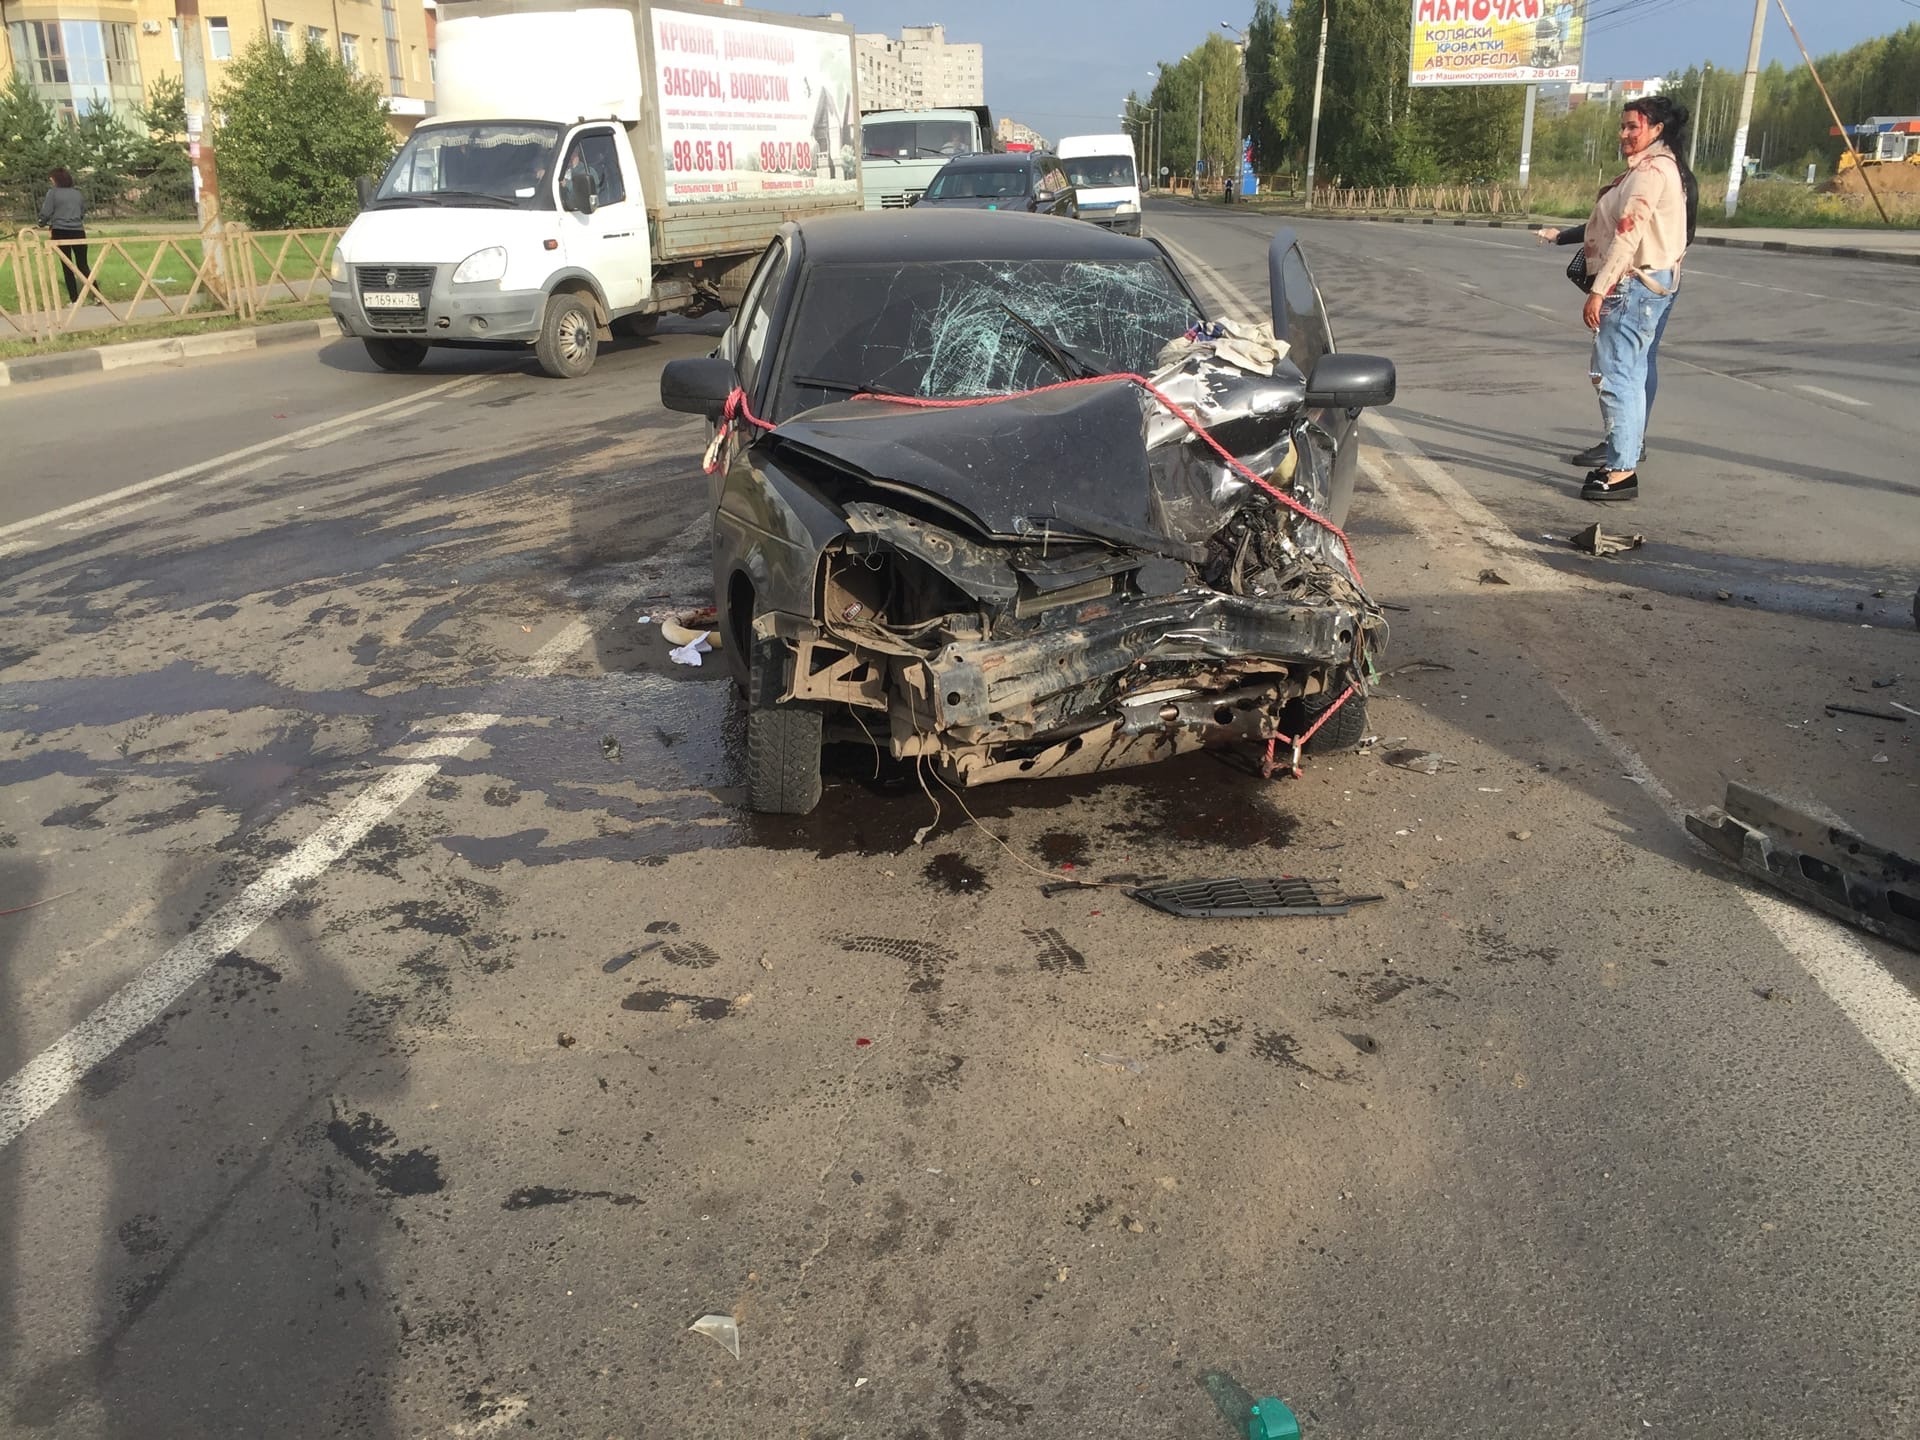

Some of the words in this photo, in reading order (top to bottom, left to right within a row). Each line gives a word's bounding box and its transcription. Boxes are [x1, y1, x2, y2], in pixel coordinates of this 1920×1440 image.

[1418, 0, 1539, 22] МАМОЧКИ
[1426, 27, 1492, 42] КОЛЯСКИ
[1437, 40, 1504, 54] КРОВАТКИ
[1425, 53, 1520, 68] АВТОКРЕСЛА
[1416, 73, 1434, 82] пр-т
[1532, 69, 1577, 79] 28-01-28
[664, 66, 726, 103] ЗАБОРЫ,
[730, 72, 790, 105] ВОДОСТОК
